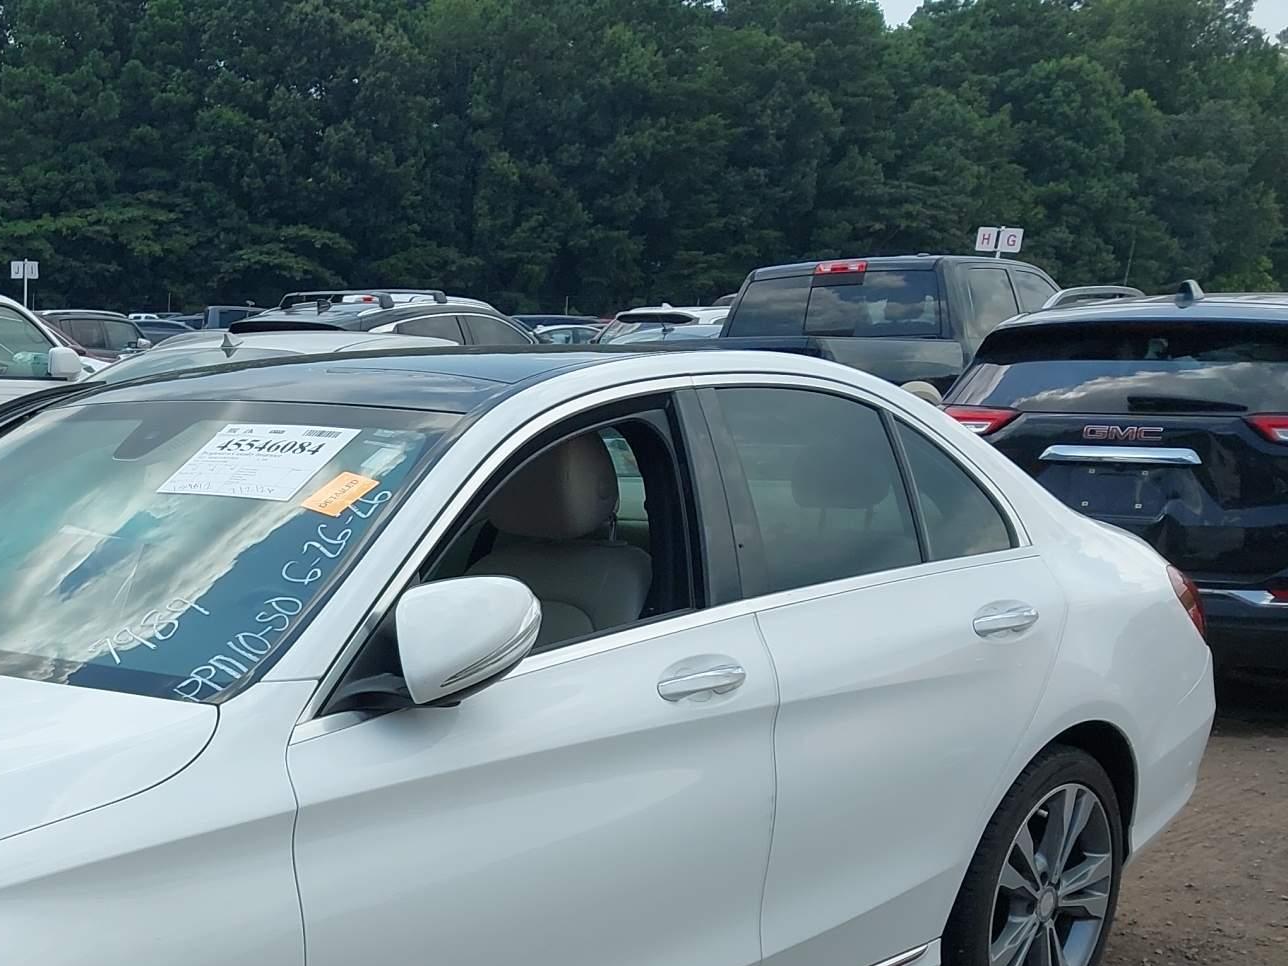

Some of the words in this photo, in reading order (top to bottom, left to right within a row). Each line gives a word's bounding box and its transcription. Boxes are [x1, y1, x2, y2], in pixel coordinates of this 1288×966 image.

[980, 233, 991, 246] H
[1006, 234, 1017, 247] G
[14, 264, 20, 275] J
[1082, 424, 1164, 441] GMC
[217, 438, 327, 456] 45546084
